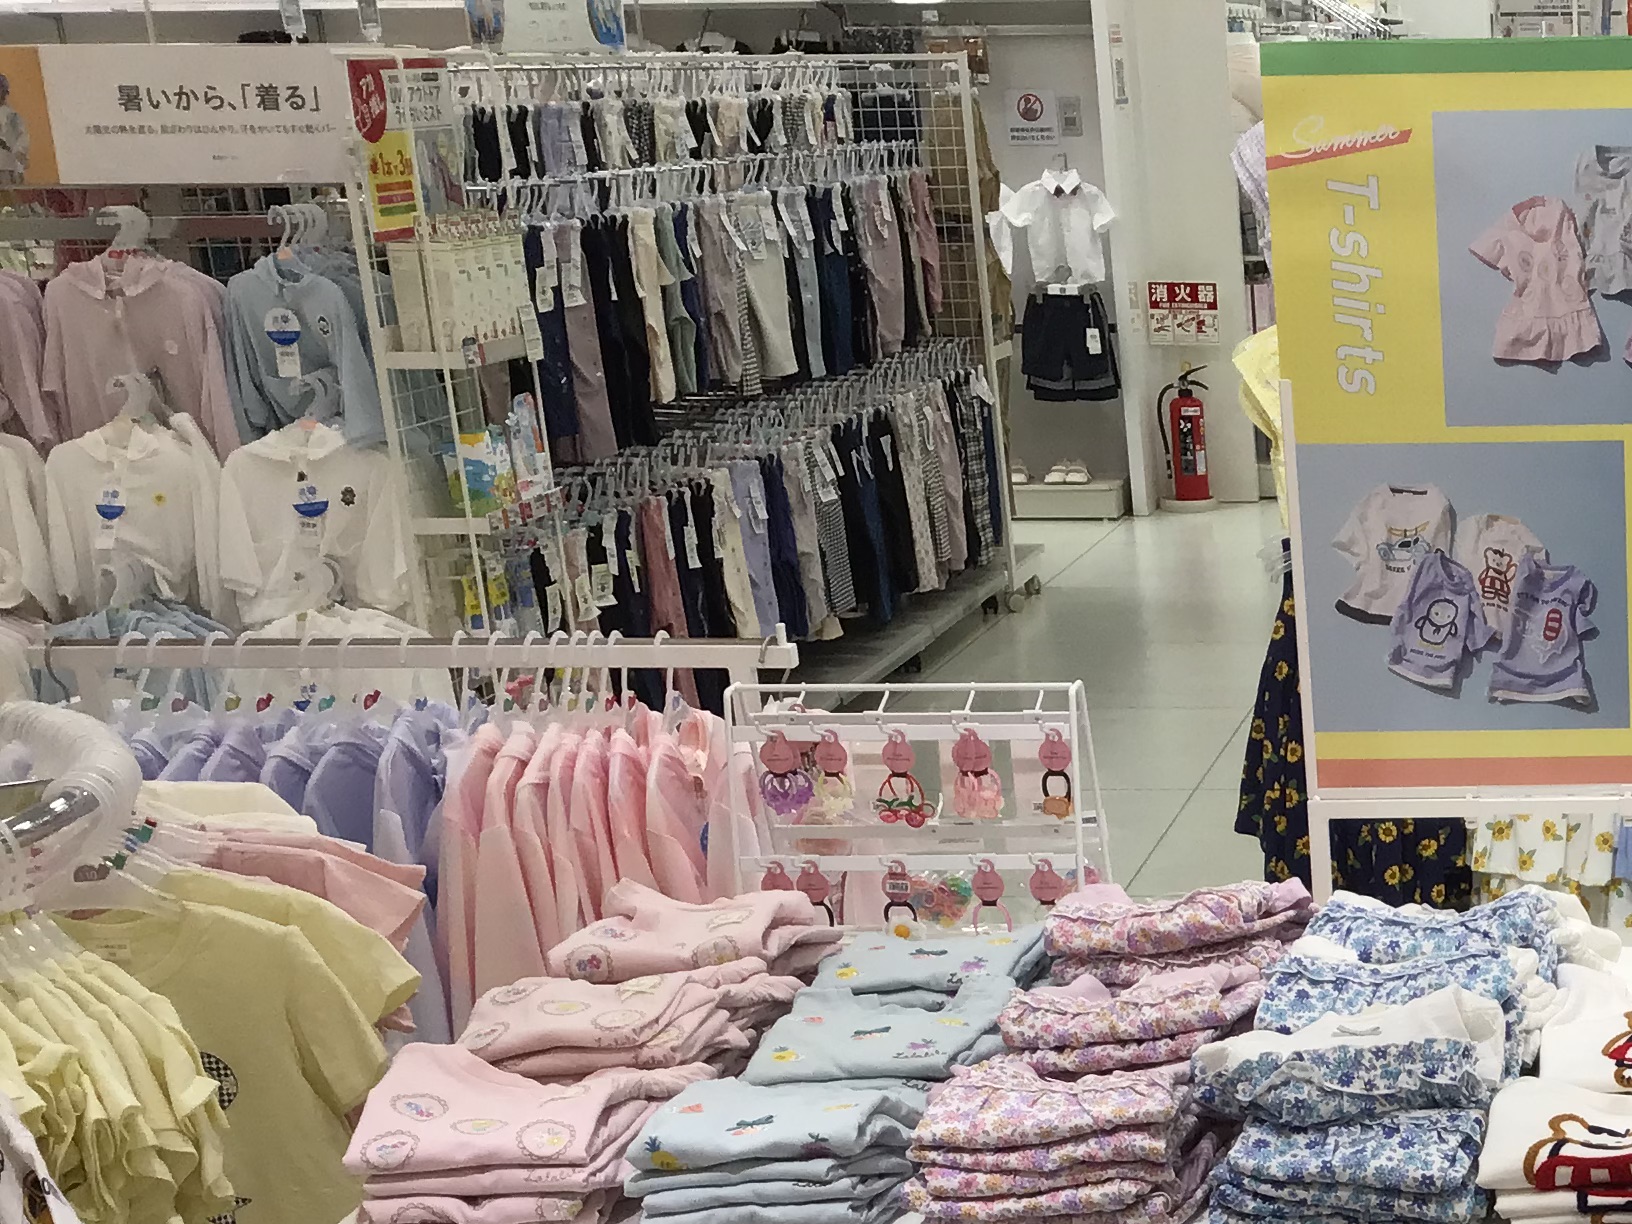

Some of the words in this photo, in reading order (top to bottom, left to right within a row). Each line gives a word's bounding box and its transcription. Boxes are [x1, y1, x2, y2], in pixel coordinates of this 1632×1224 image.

[117, 83, 321, 112] 暑いから、「着る」
[1281, 114, 1402, 160] Summer
[1151, 284, 1214, 302] 消火器
[1325, 174, 1385, 396] T-shirts
